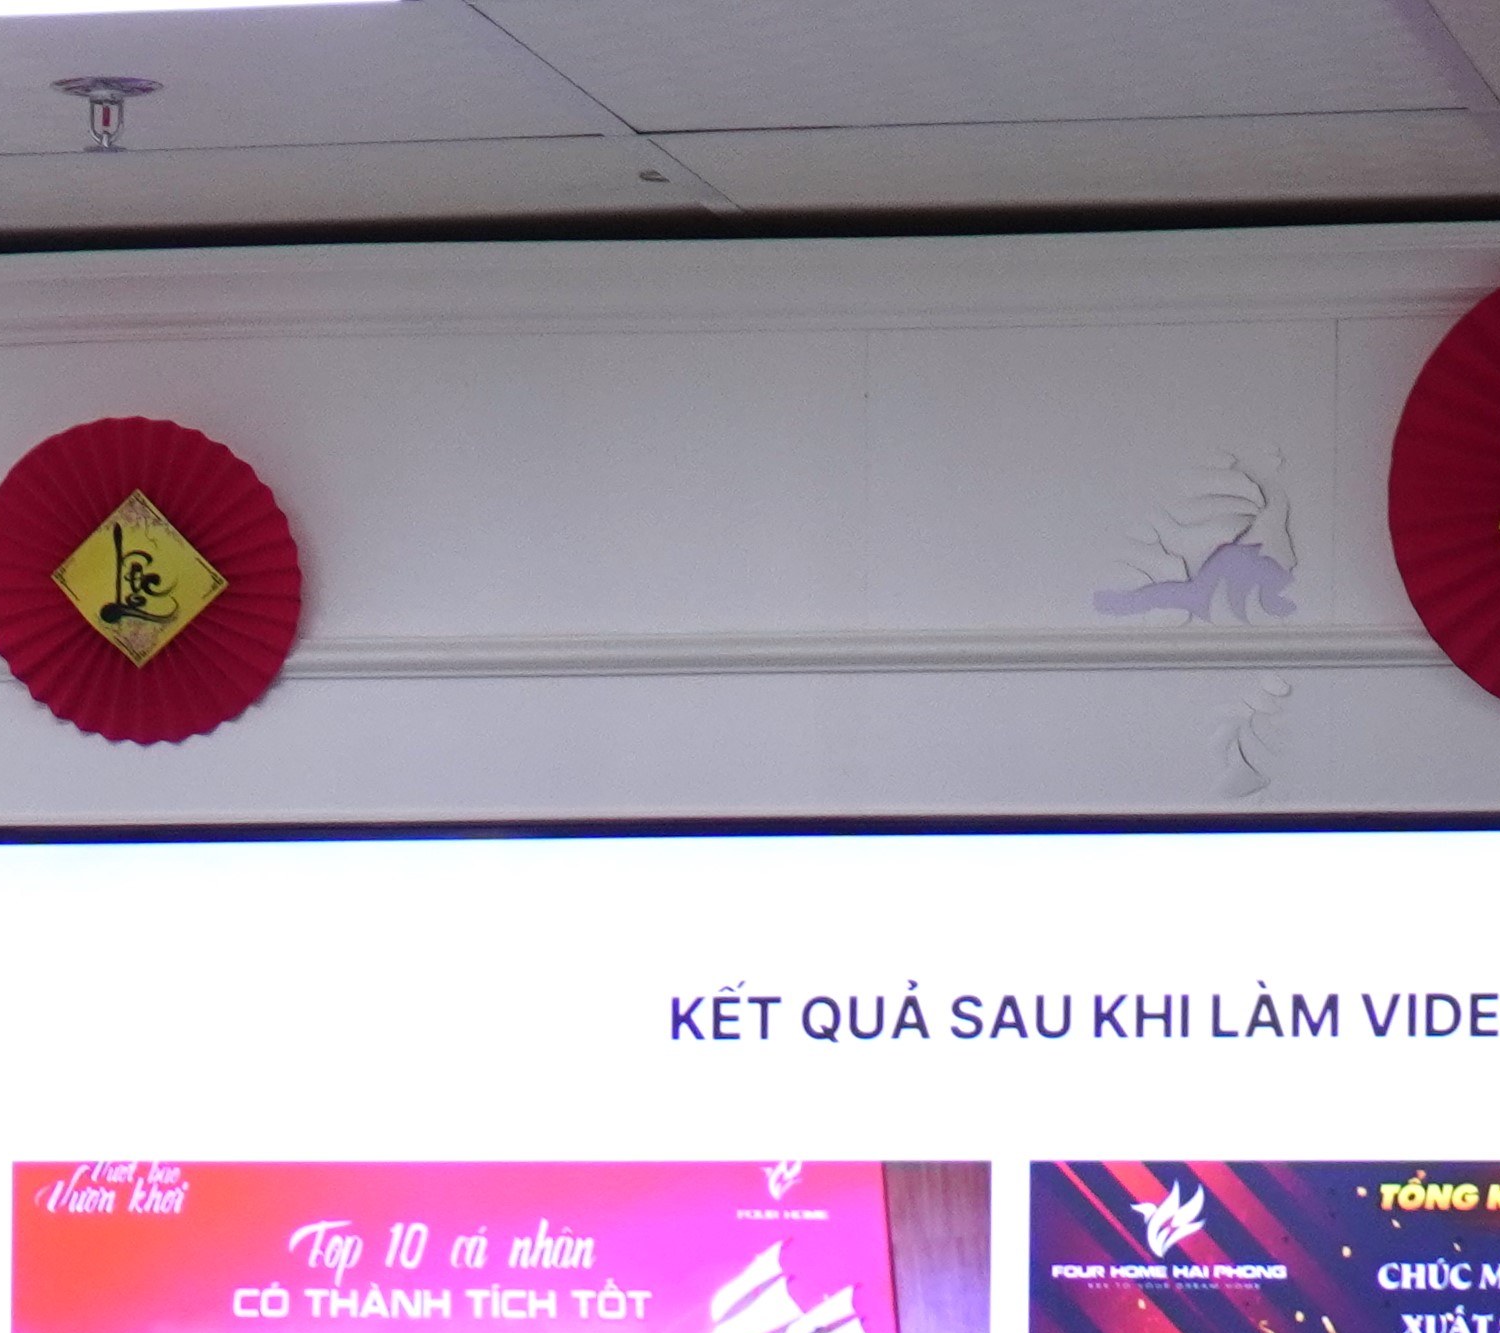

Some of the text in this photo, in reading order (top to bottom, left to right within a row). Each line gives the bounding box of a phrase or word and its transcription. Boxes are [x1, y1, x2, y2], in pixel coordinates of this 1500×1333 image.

[670, 979, 783, 1041] KẾT
[801, 979, 931, 1043] QUẢ
[950, 994, 1072, 1039] SAU
[1093, 993, 1190, 1038] KHI
[1211, 979, 1339, 1037] LÀM
[1379, 1169, 1481, 1211] TỔNG
[289, 1217, 597, 1287] Top 10 cá nhân
[1051, 1264, 1288, 1280] FOUR HOME HAI PHONG
[1377, 1256, 1473, 1291] CHÚC
[232, 1276, 654, 1320] CÓ THÀNH TÍCH TỐT
